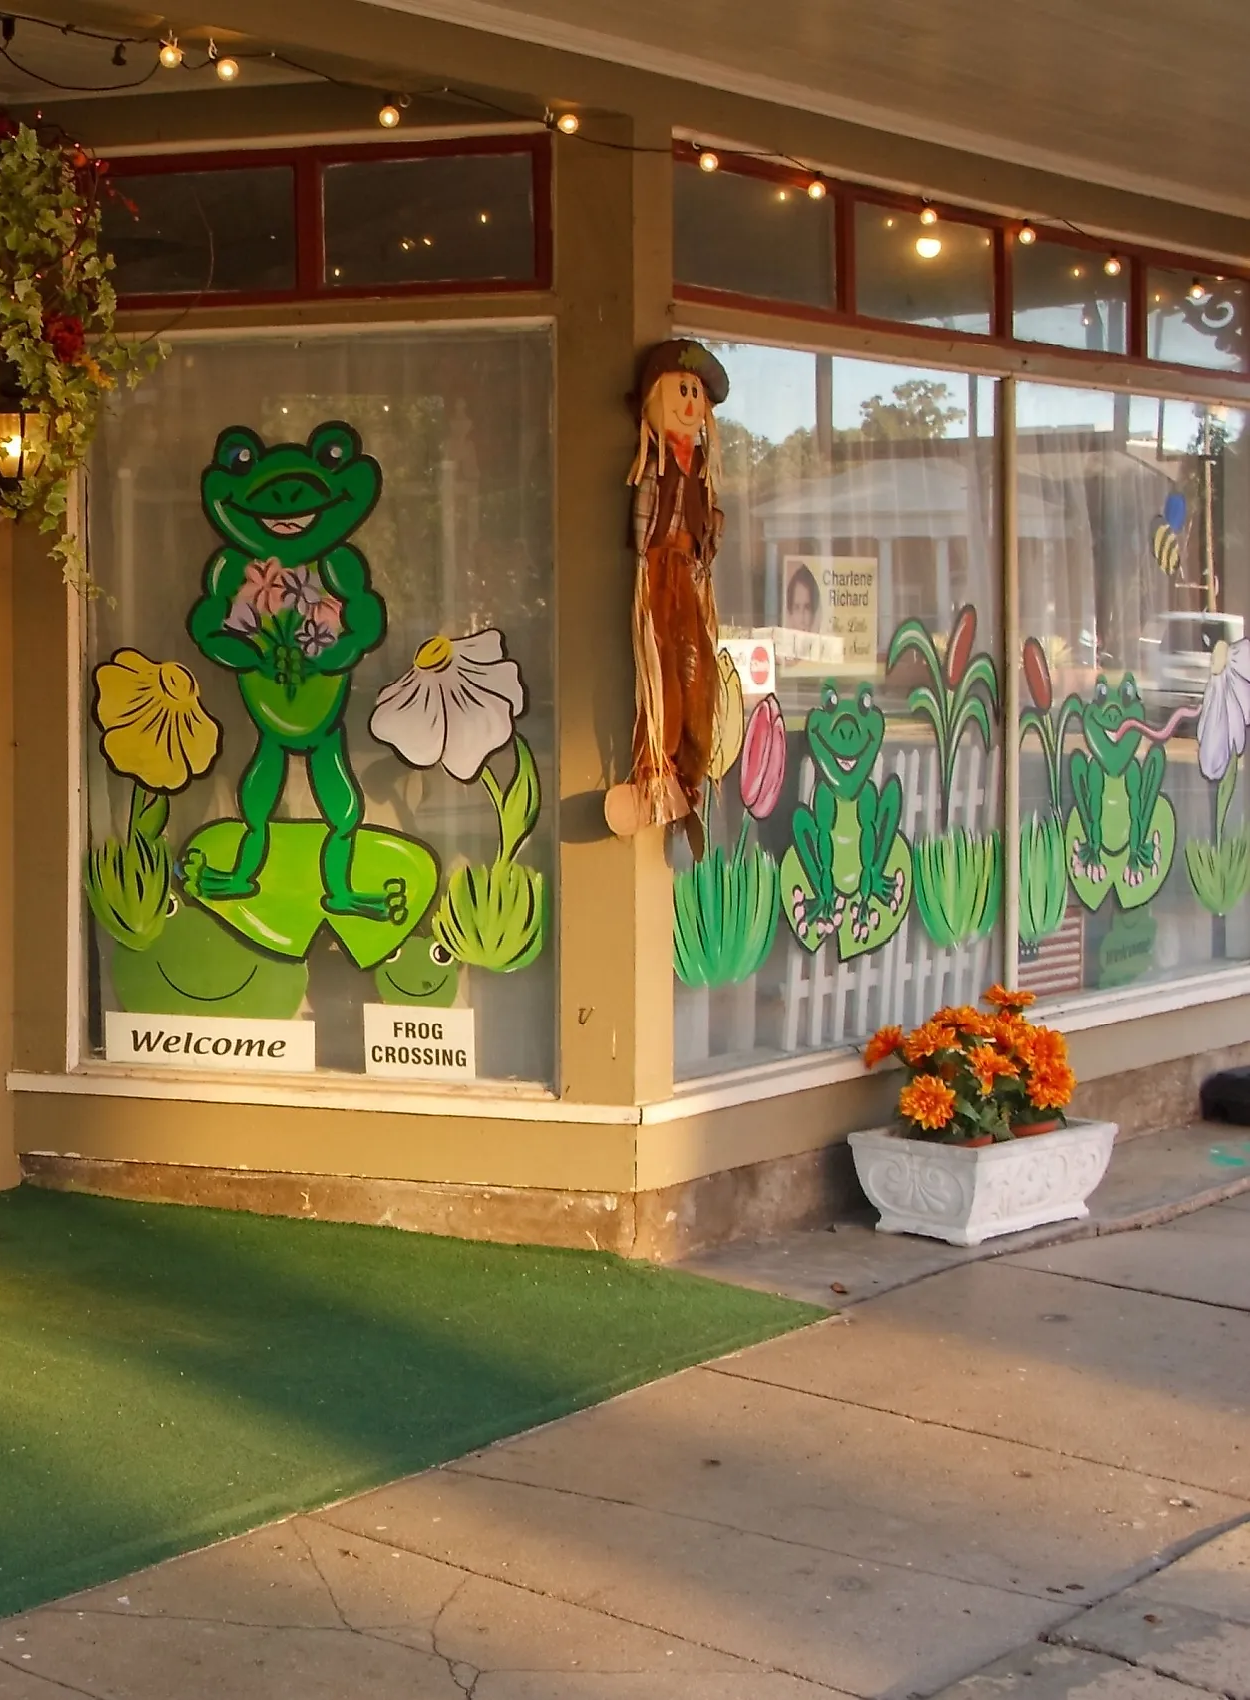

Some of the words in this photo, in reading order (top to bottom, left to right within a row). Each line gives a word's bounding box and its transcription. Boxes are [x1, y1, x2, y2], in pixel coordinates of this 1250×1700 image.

[822, 569, 873, 587] Charlene
[829, 589, 869, 607] Richard
[393, 1021, 443, 1040] FROG
[131, 1029, 287, 1058] Welcome
[371, 1045, 467, 1067] CROSSING
